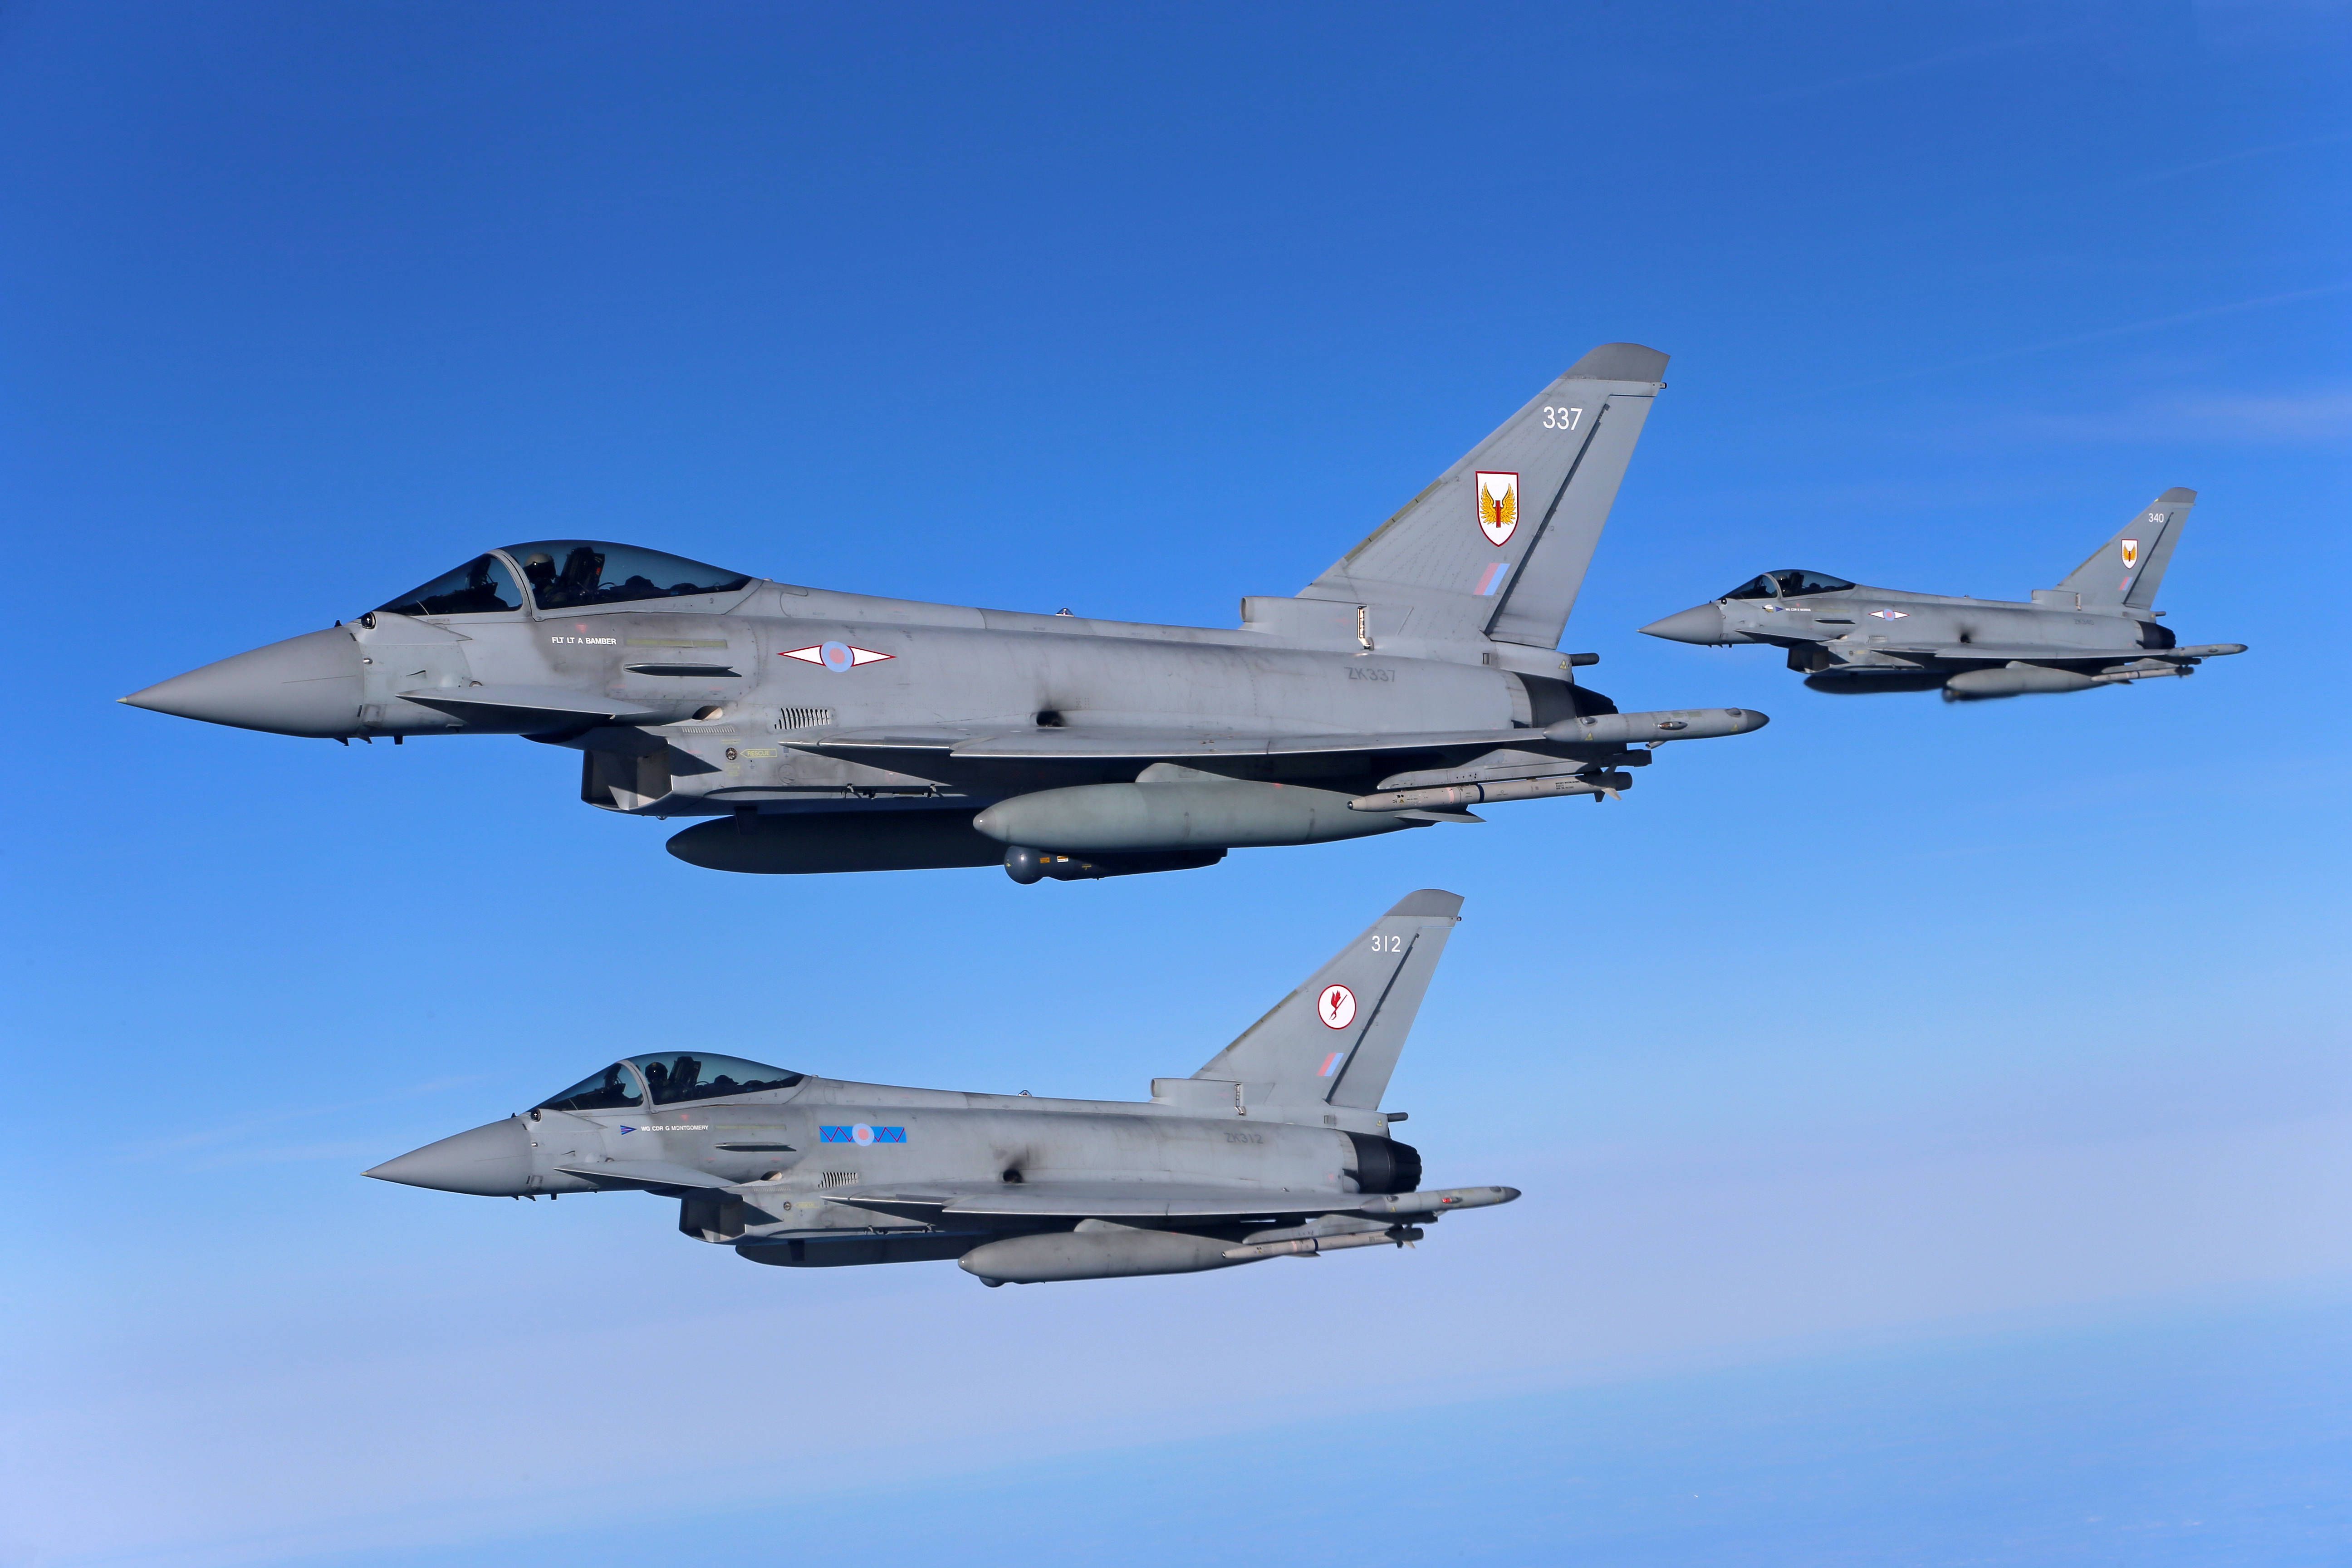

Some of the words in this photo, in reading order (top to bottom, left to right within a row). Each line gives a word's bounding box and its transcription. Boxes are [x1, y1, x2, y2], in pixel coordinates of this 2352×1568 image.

[1543, 406, 1583, 430] 337
[2148, 513, 2164, 523] 340
[1343, 666, 1395, 682] ZK337
[1372, 935, 1401, 952] 312
[1223, 1132, 1264, 1144] ZK312
